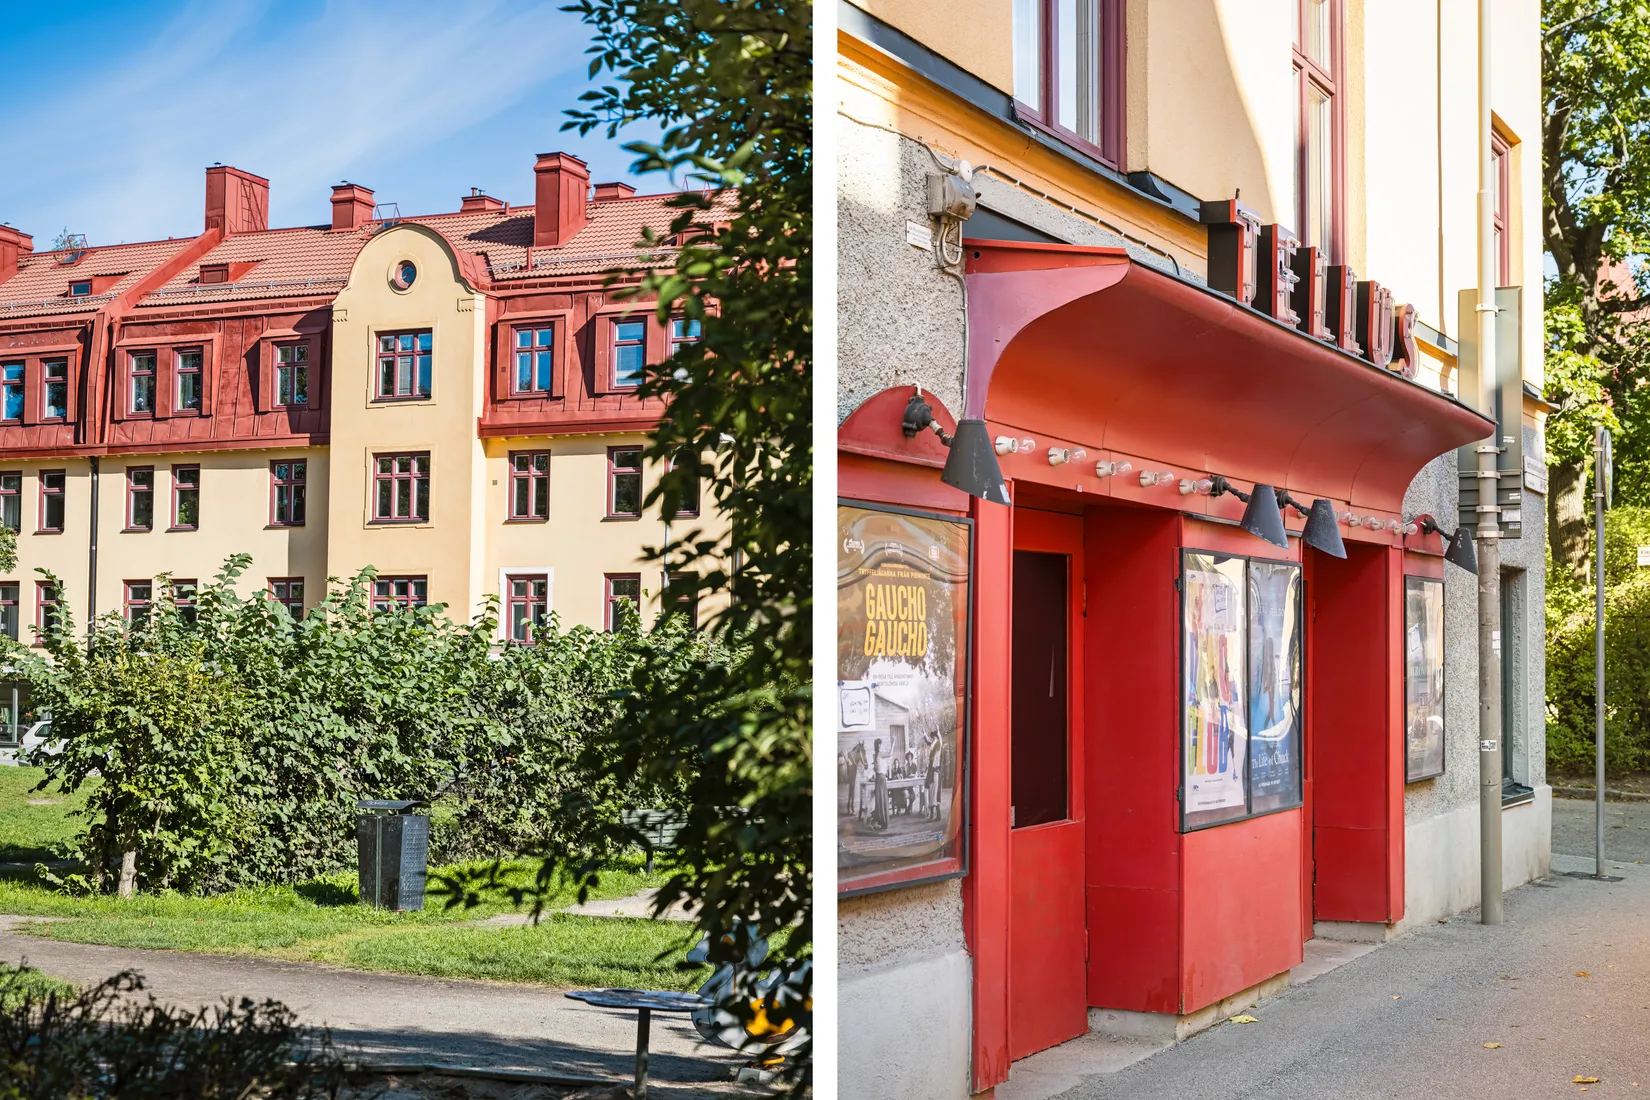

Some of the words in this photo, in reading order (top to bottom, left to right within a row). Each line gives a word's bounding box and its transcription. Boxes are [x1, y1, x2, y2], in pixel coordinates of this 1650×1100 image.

[865, 583, 926, 621] GAUCHO
[863, 620, 928, 656] GAUCHO
[1188, 705, 1230, 776] CLUB
[1251, 758, 1259, 769] The
[1258, 752, 1268, 768] Life
[1273, 749, 1289, 765] Chuck
